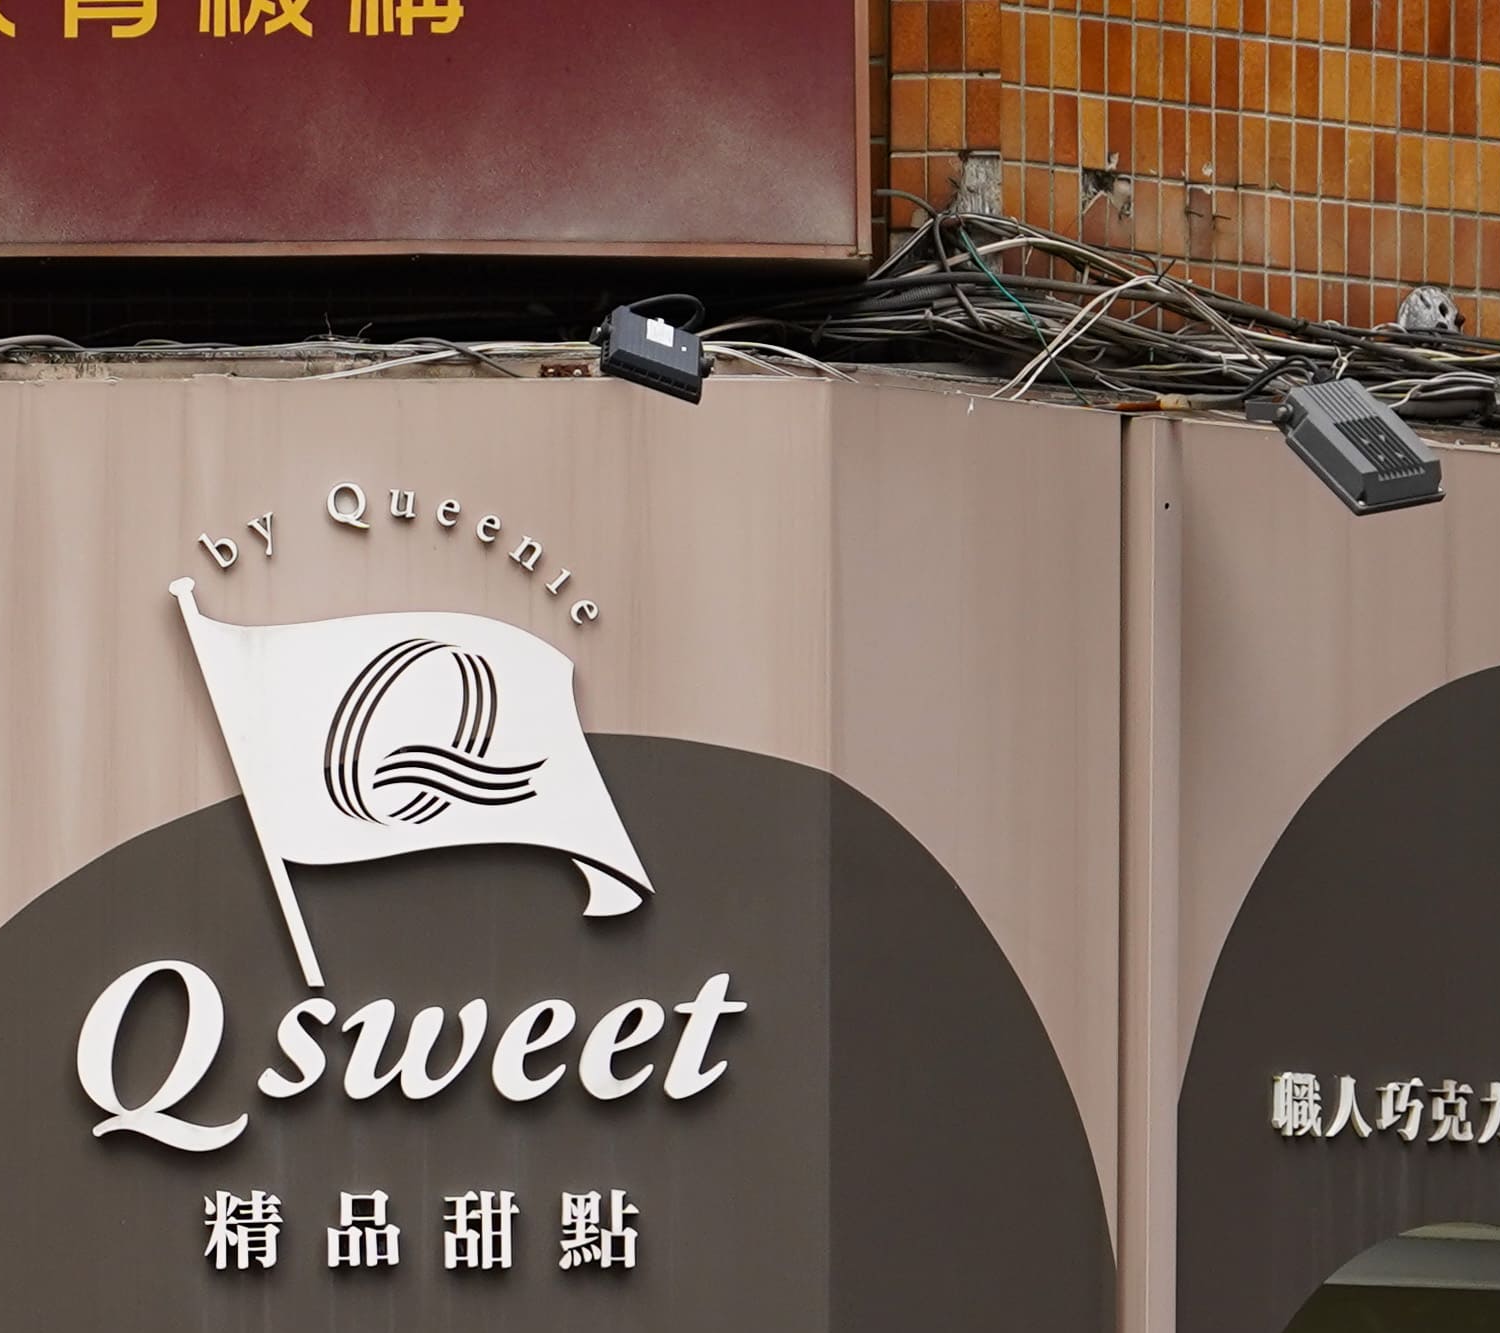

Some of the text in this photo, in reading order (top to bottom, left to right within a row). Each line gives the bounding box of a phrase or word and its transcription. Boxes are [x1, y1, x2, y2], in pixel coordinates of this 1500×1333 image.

[197, 481, 600, 627] by Queenie
[203, 1189, 640, 1270] 精品甜點
